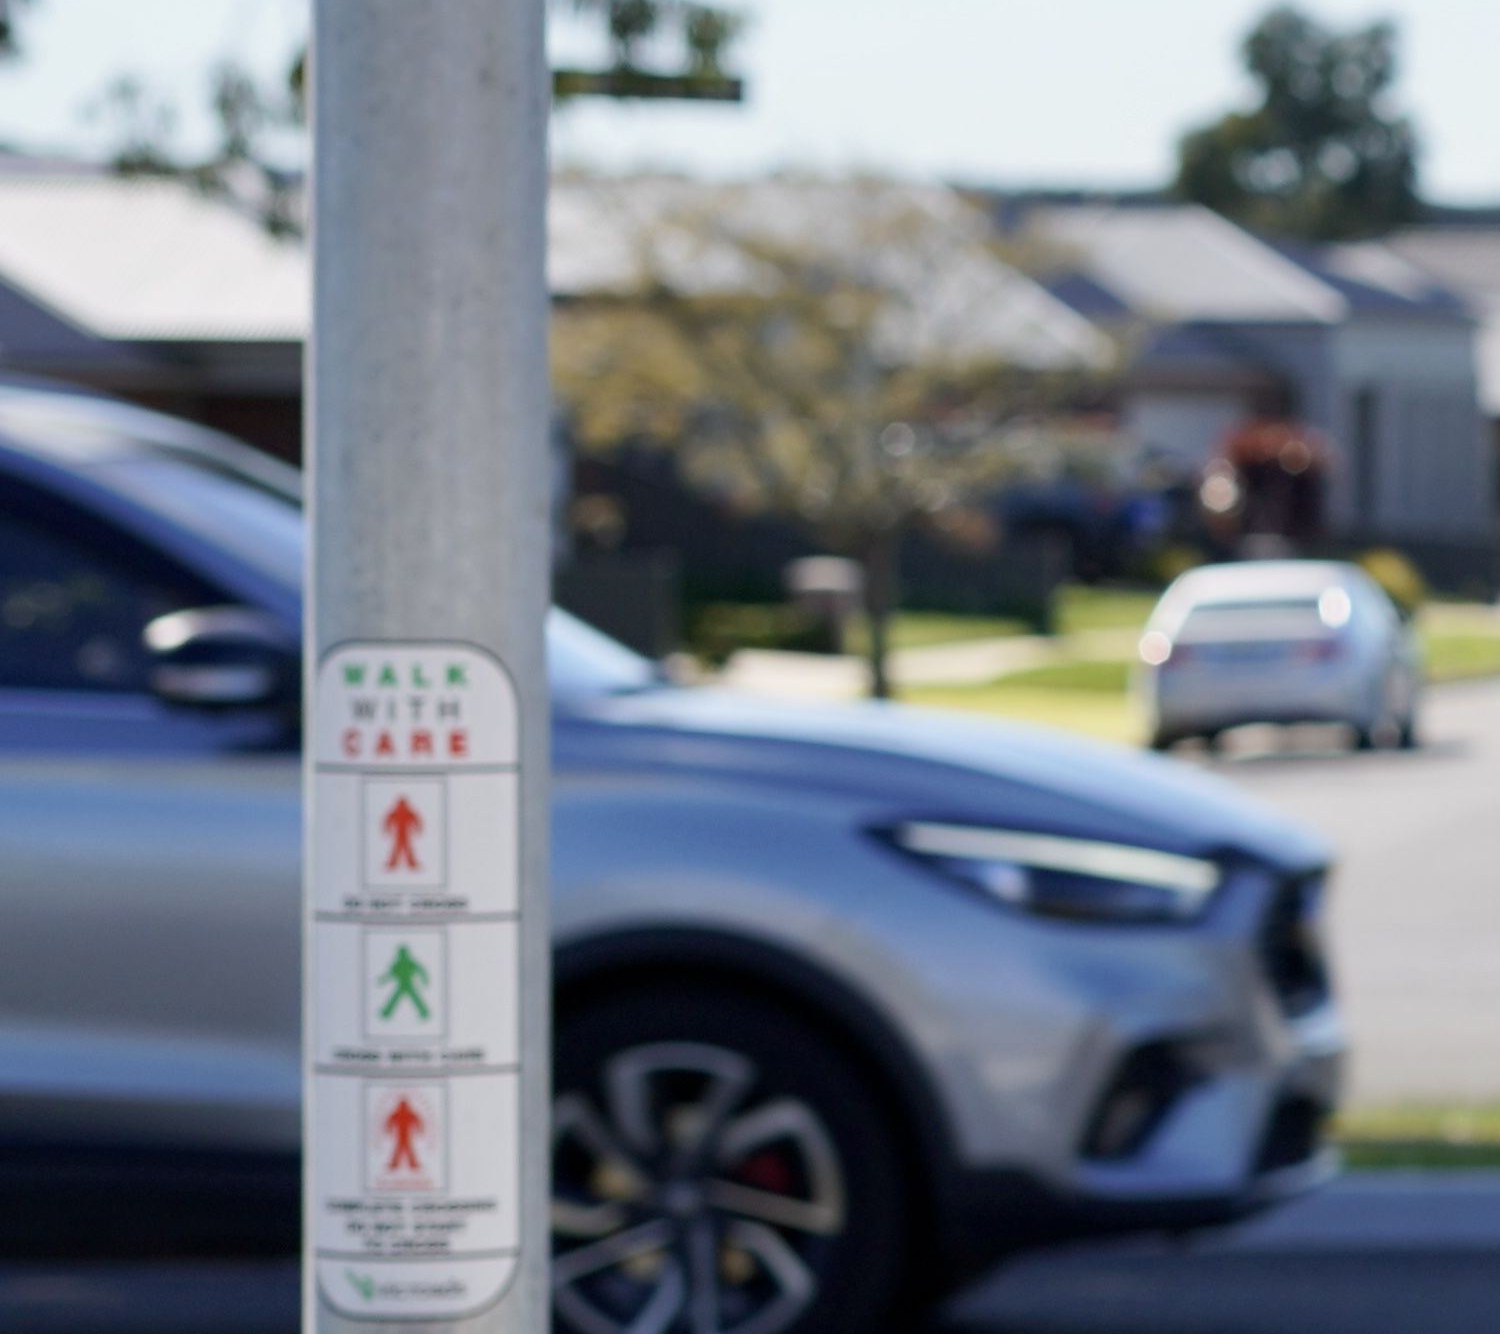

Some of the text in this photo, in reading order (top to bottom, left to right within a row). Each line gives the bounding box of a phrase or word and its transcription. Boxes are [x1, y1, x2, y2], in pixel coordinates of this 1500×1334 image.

[342, 662, 469, 687] WALK
[352, 696, 461, 720] WITH
[342, 728, 469, 756] CARE
